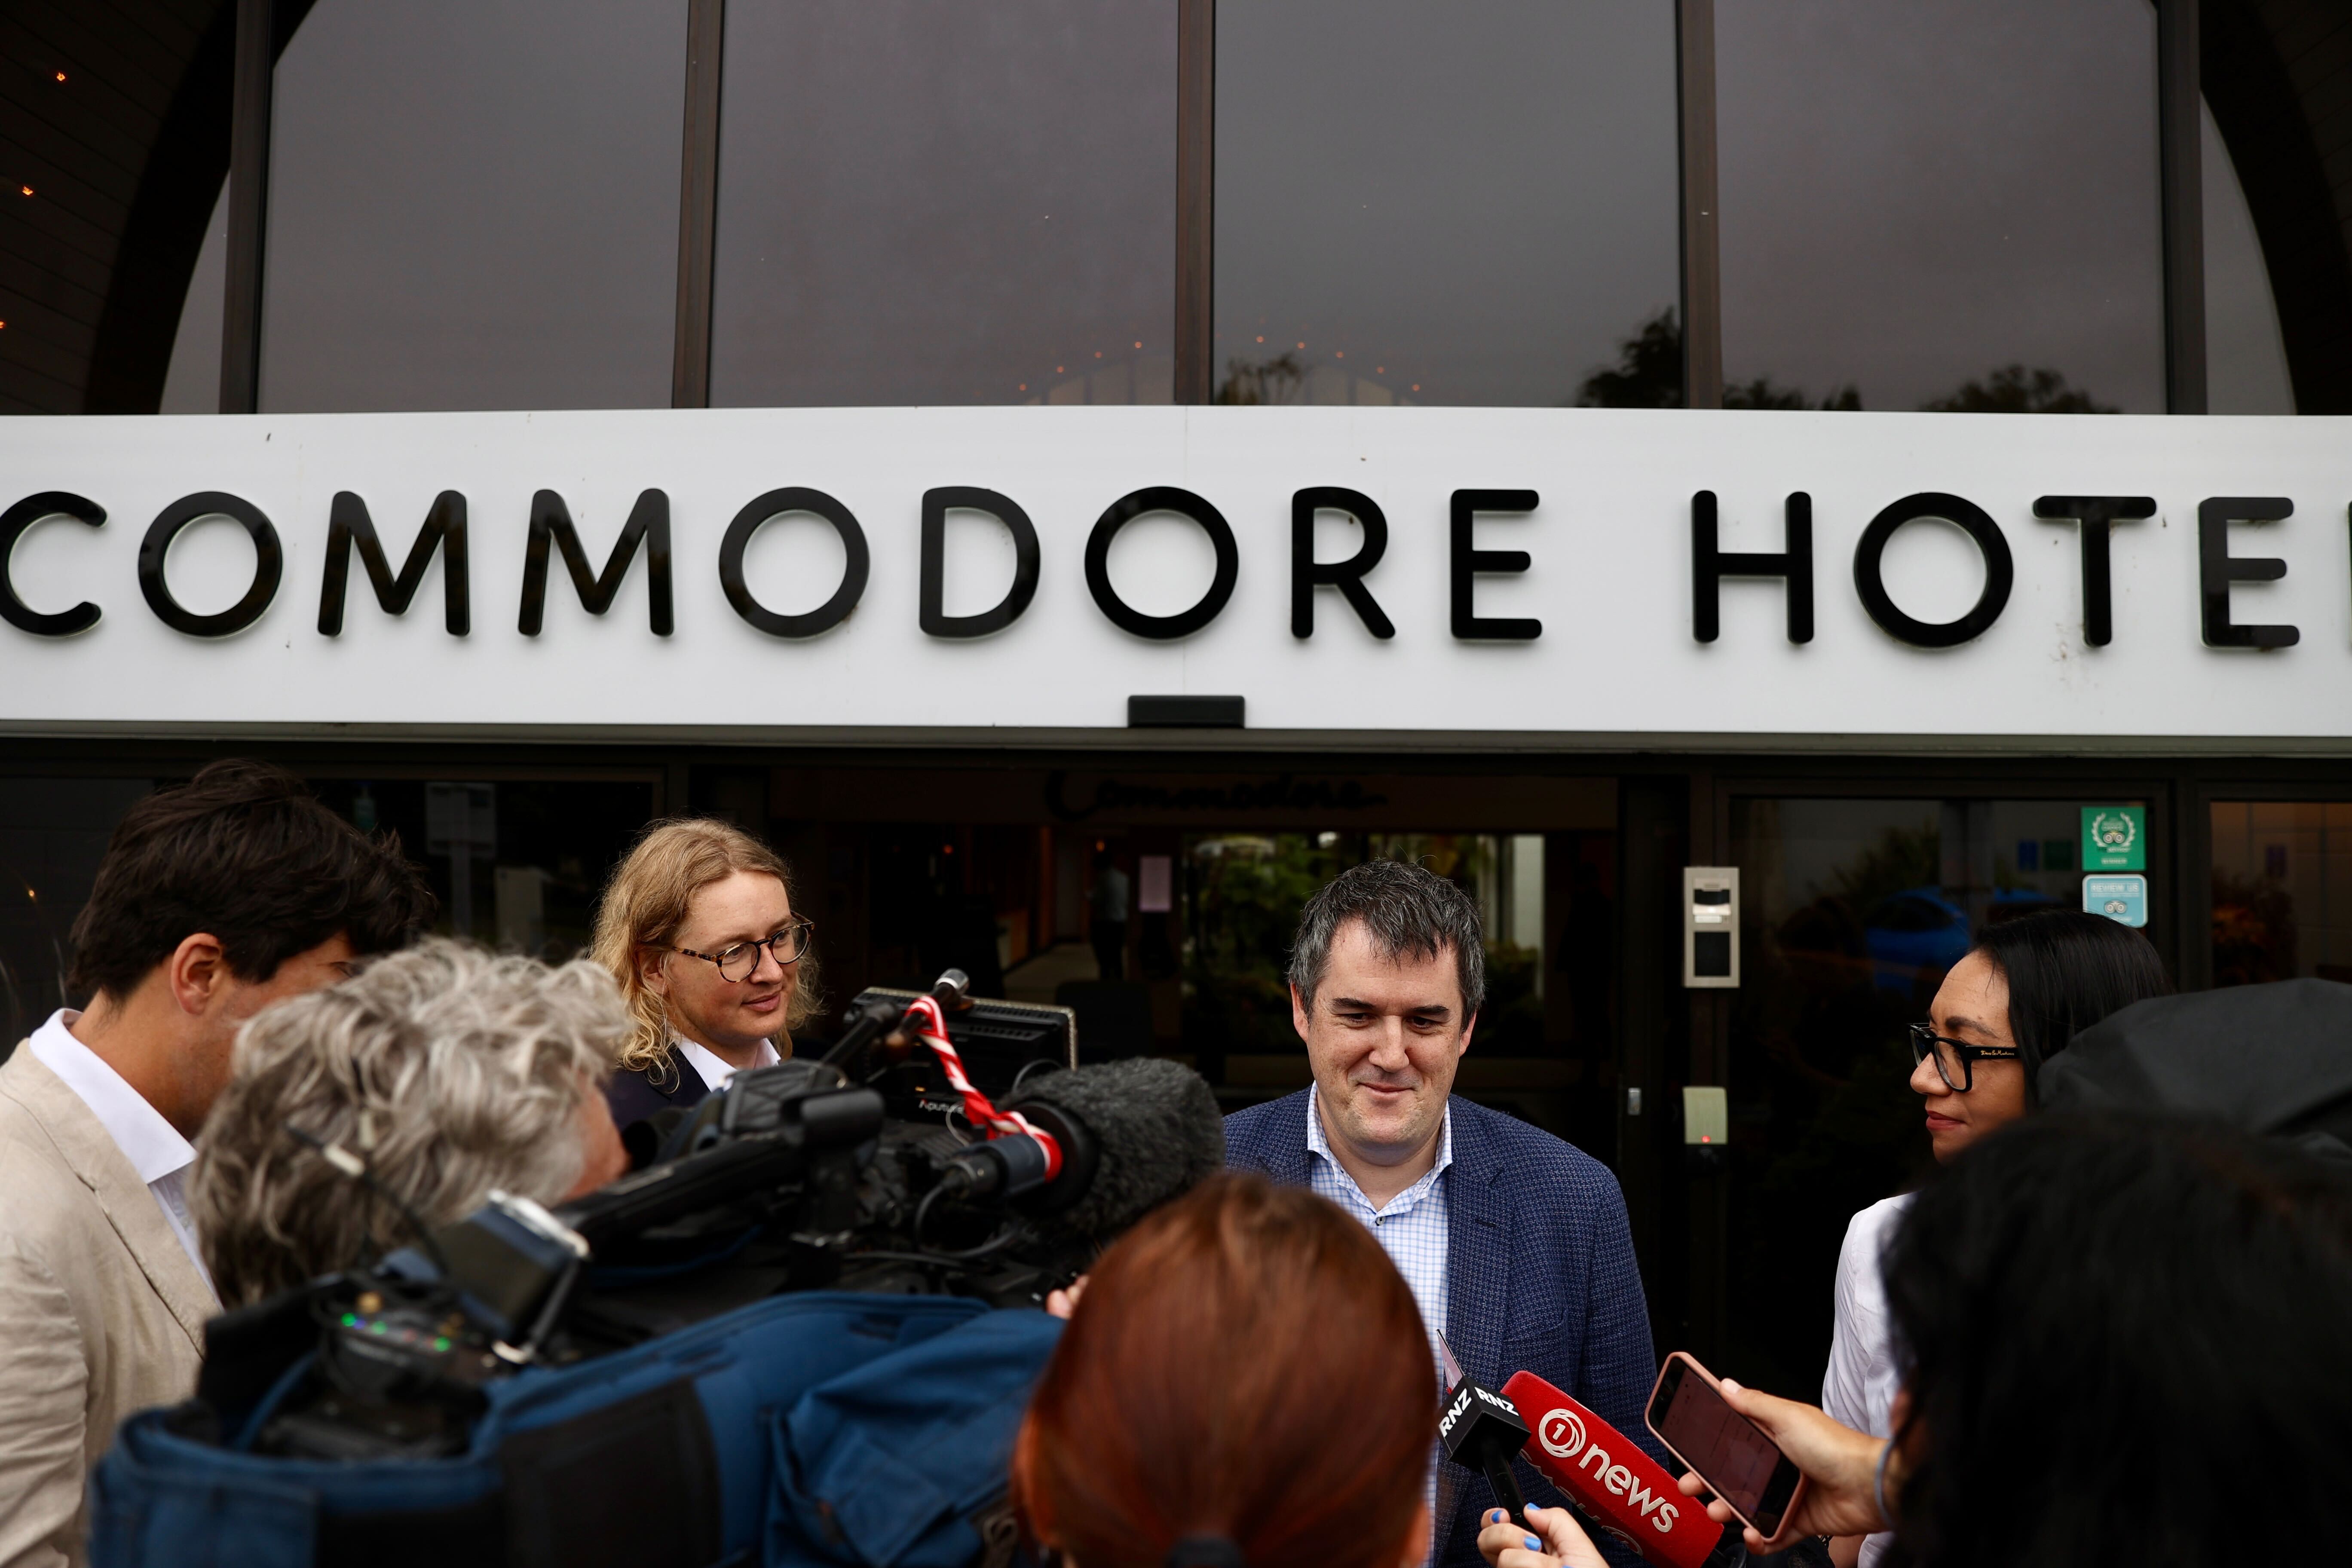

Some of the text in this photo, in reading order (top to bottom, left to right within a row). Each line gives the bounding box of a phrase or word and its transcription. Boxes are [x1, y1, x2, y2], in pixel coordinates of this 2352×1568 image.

[0, 486, 2352, 648] COMMODORE HOTE
[1044, 770, 1388, 822] Commodore
[2091, 884, 2139, 892] REVIEW US
[1439, 1388, 1472, 1438] RNZ
[1474, 1387, 1519, 1416] RNZ
[1578, 1443, 1679, 1533] news
